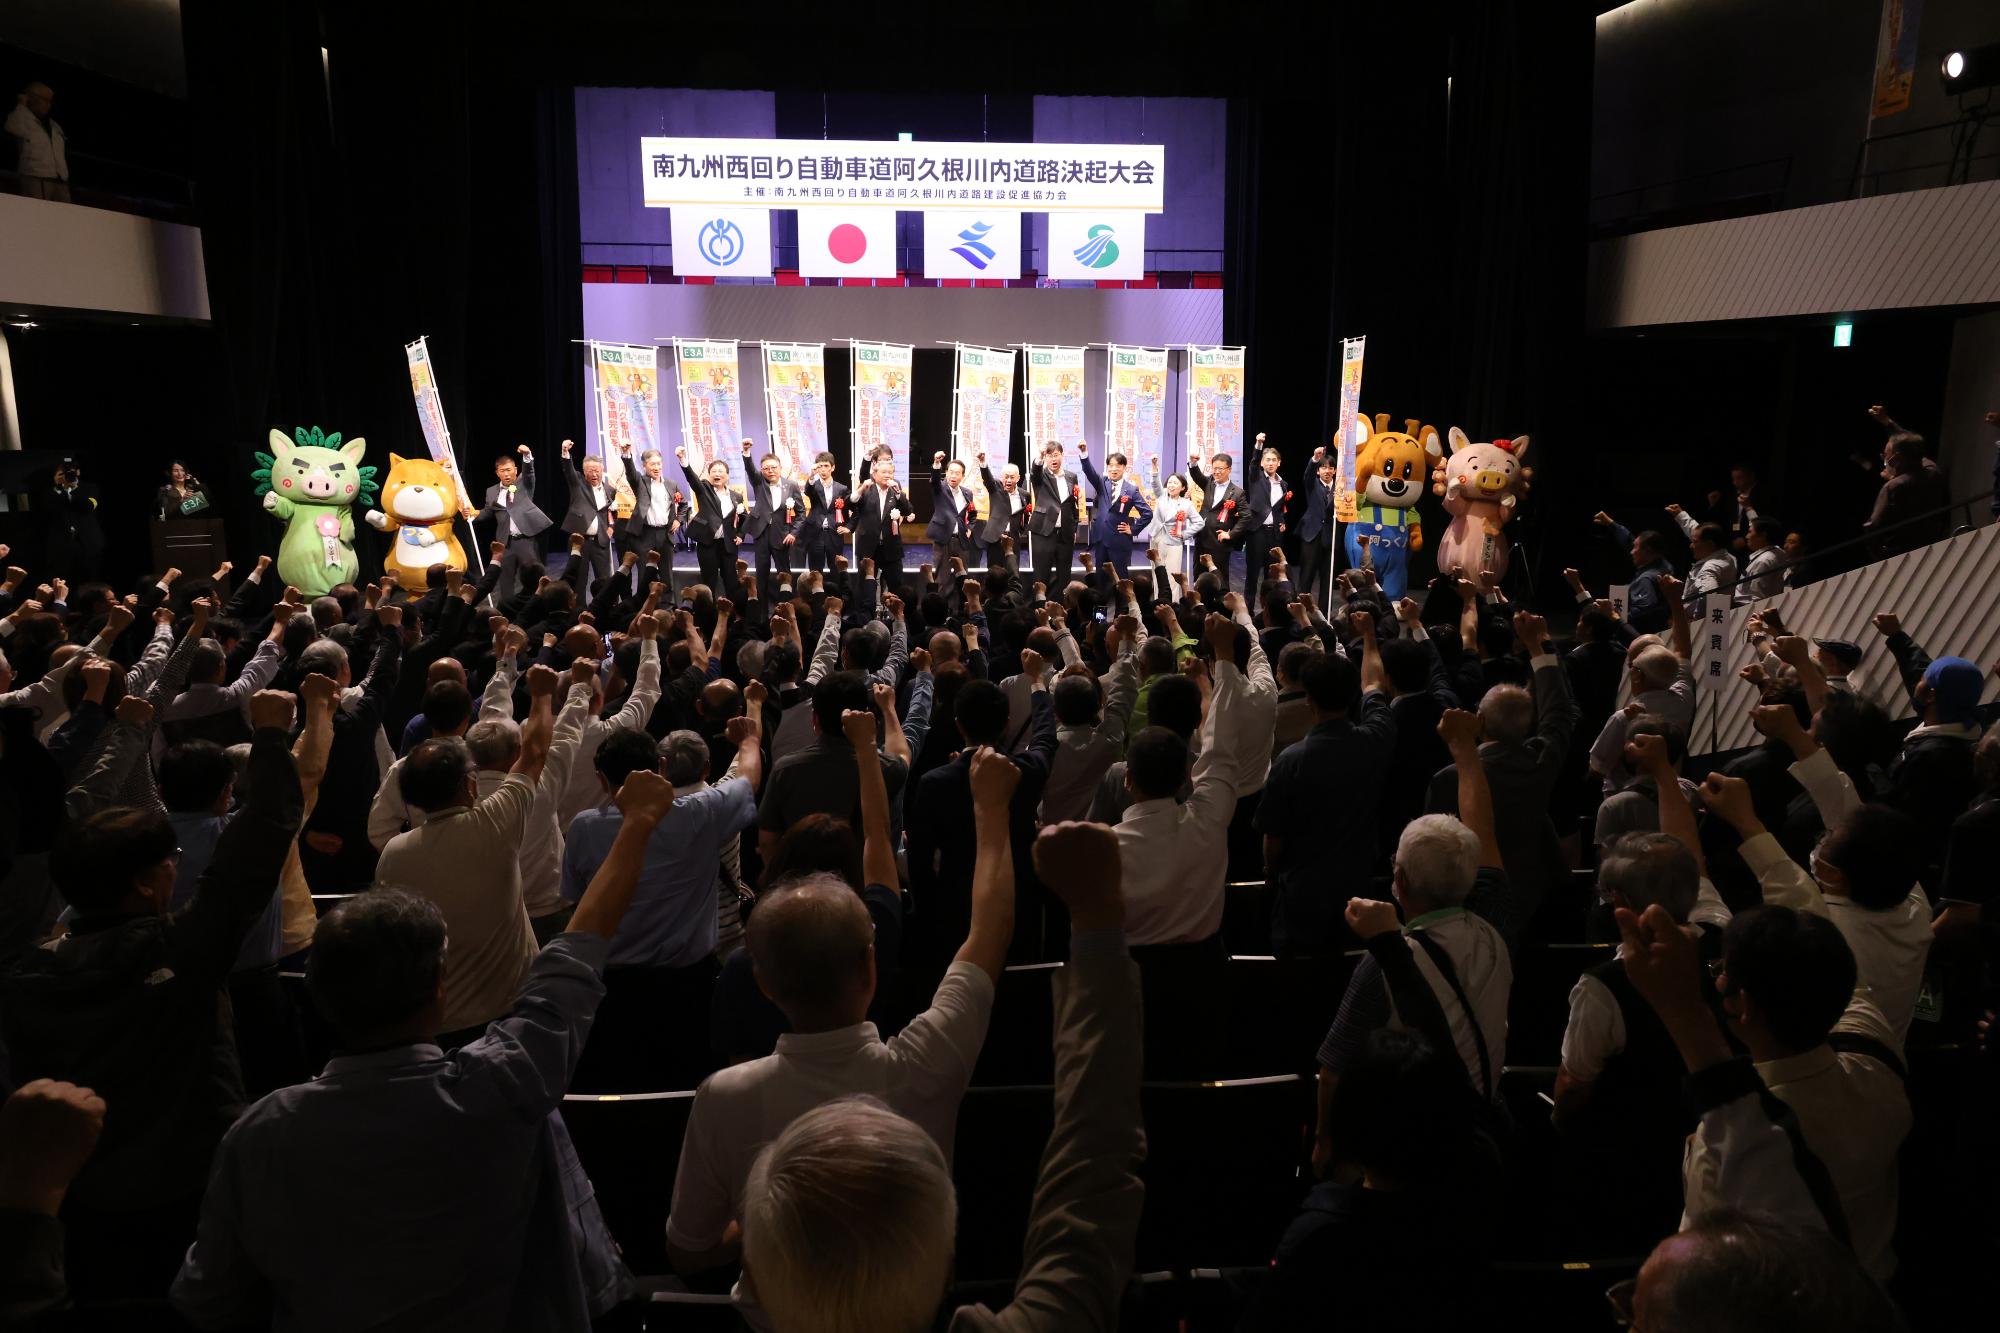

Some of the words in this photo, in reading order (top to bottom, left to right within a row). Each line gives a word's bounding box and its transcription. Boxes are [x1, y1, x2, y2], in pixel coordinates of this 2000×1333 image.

[652, 152, 1155, 185] 南九州西回り自動車道阿久根川内道路決起大会
[603, 351, 621, 362] E3A
[684, 347, 703, 358] E3A
[770, 350, 790, 361] E3A
[859, 349, 879, 360] E3A
[964, 353, 983, 365] E3A
[1032, 353, 1051, 364] E3A
[1117, 353, 1136, 364] E3A
[183, 497, 203, 510] E3A
[1710, 608, 1724, 677] 来賓席
